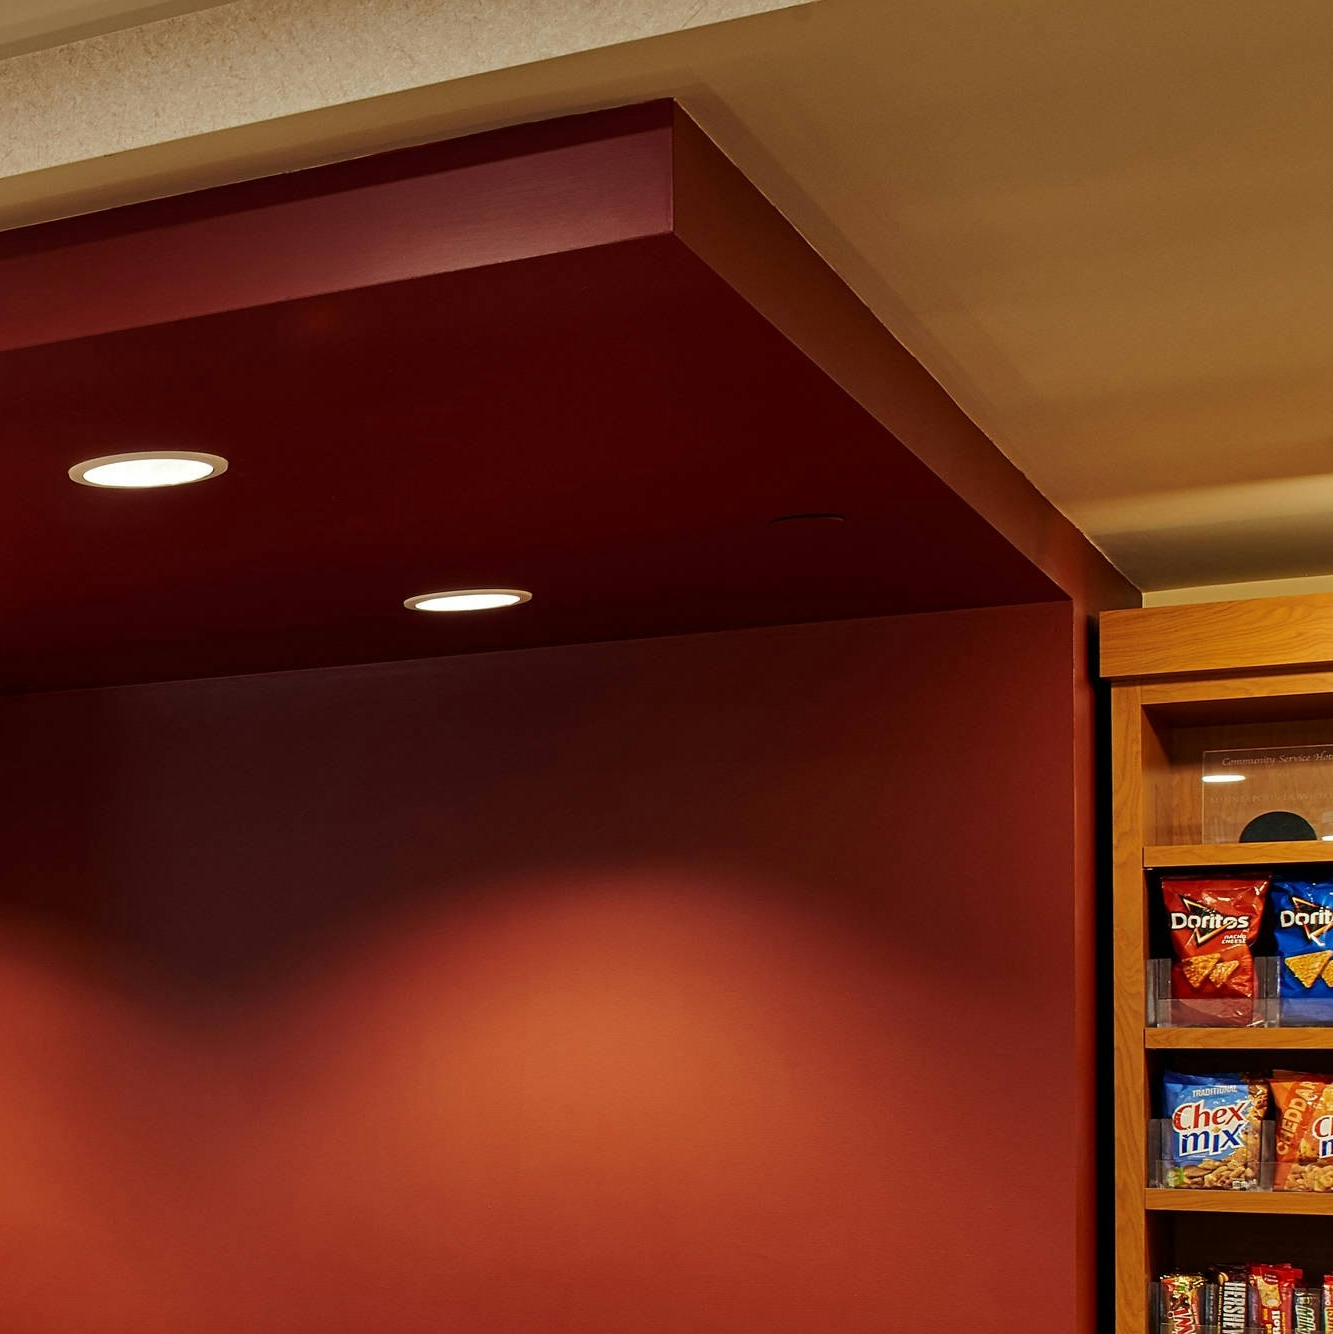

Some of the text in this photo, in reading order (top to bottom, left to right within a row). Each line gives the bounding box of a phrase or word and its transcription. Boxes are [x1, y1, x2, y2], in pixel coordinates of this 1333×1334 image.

[1279, 754, 1310, 763] Service
[1171, 910, 1249, 929] Doritos
[1192, 1085, 1238, 1097] TRADITIONAL
[1172, 1100, 1249, 1132] Chex
